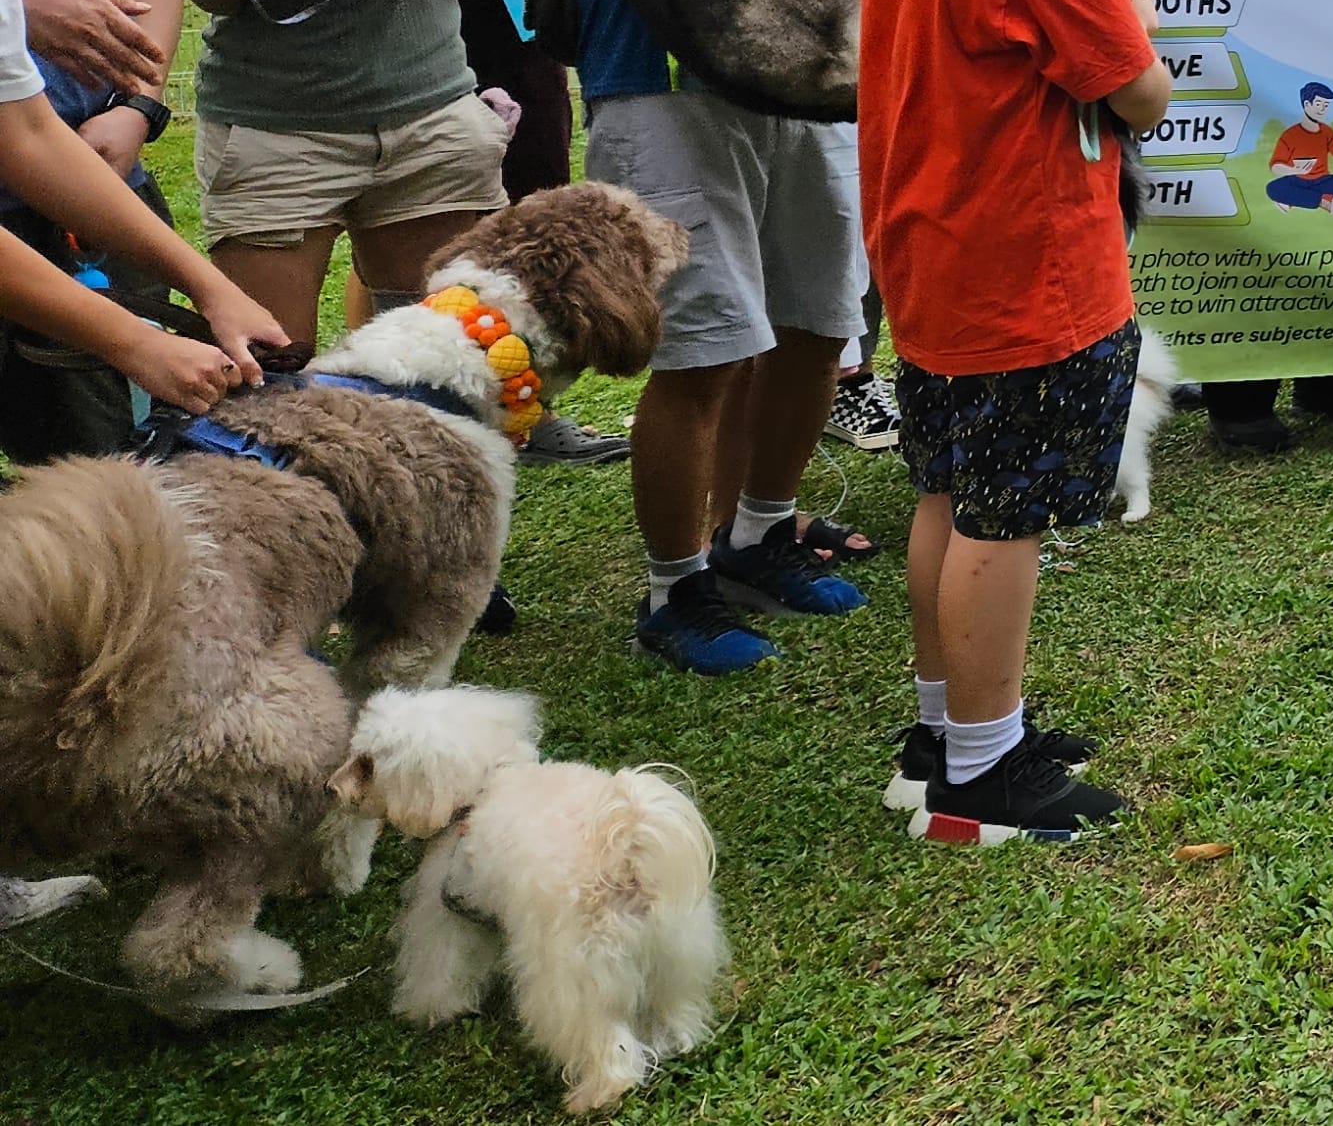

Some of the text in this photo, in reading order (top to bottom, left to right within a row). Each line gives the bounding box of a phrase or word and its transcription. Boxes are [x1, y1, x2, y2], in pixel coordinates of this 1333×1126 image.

[1140, 248, 1210, 273] photo
[1215, 248, 1262, 267] with
[1262, 251, 1318, 271] your
[1171, 274, 1195, 290] to
[1193, 271, 1238, 295] join
[1242, 275, 1282, 289] our
[1170, 298, 1193, 315] to
[1197, 294, 1236, 313] win
[1210, 331, 1244, 345] are
